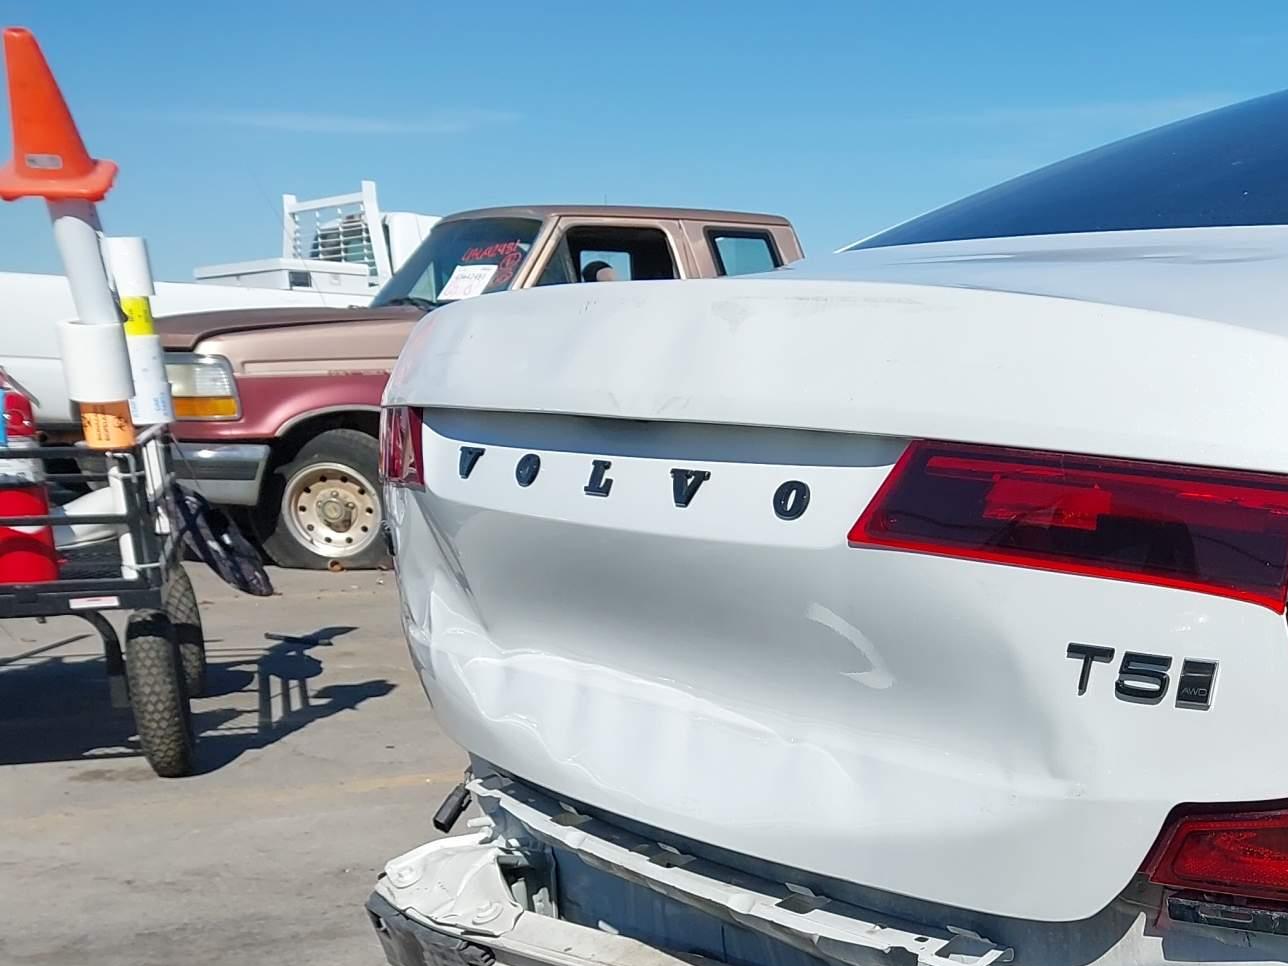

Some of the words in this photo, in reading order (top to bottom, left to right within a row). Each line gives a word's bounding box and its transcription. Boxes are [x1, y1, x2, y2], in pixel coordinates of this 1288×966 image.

[459, 446, 811, 521] VOLVO
[1066, 642, 1173, 706] T5
[1181, 687, 1208, 697] AWD
